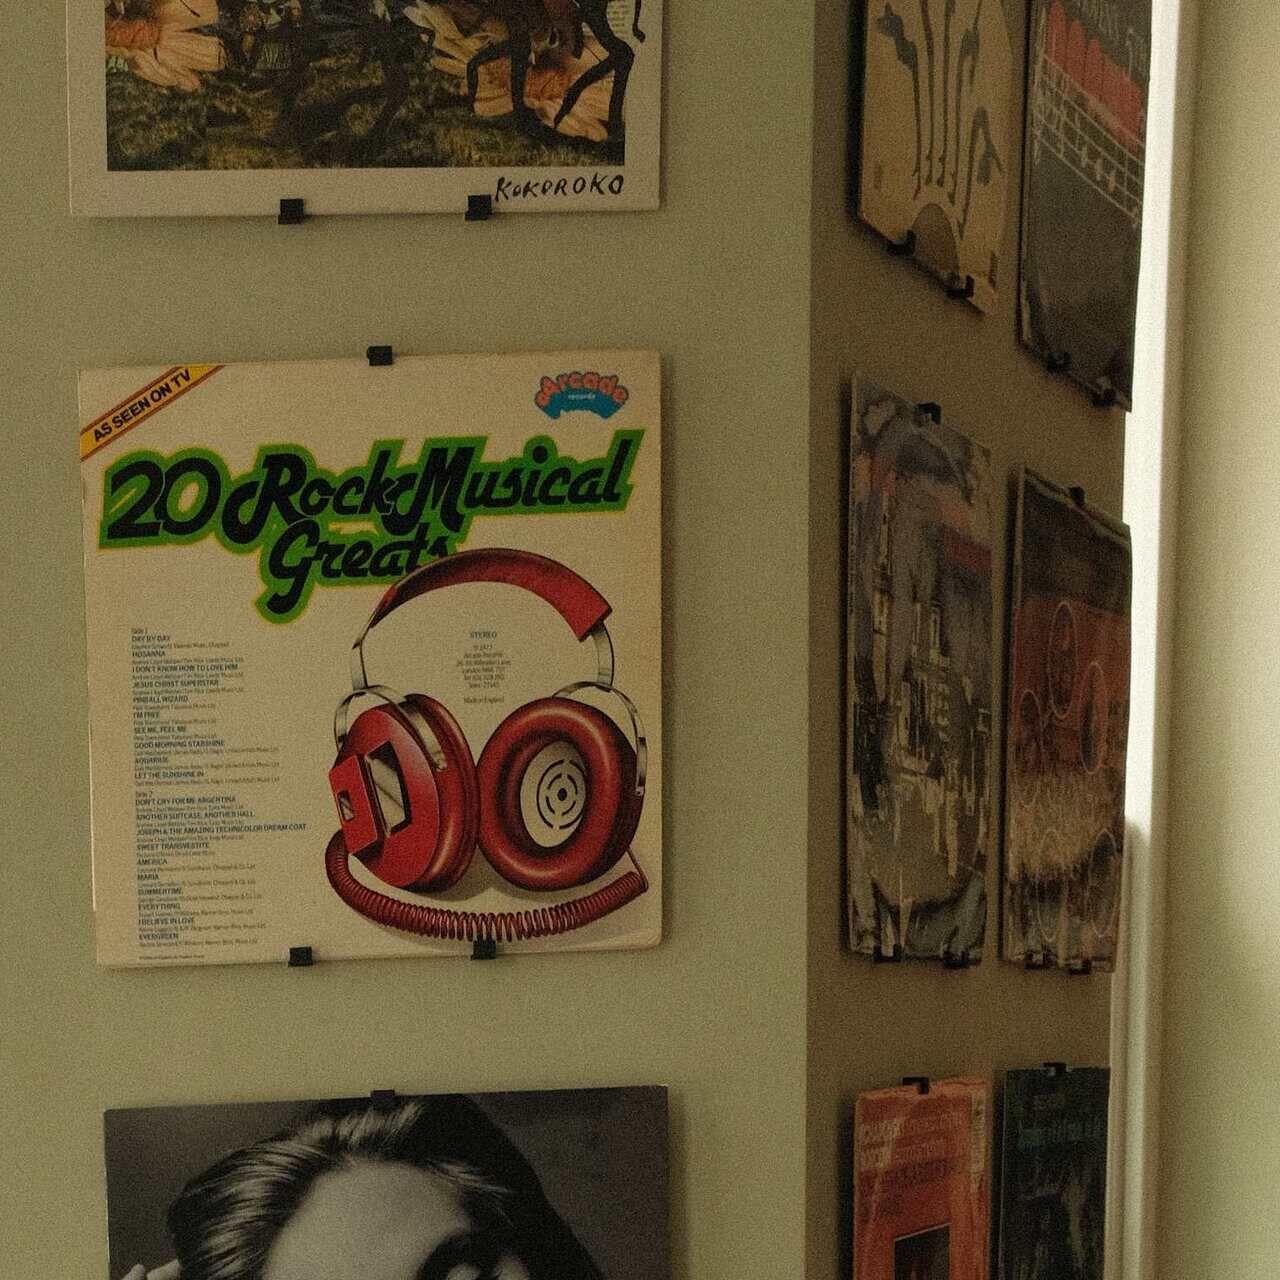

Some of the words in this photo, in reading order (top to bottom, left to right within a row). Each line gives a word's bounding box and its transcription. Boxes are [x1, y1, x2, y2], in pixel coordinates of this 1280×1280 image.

[94, 422, 113, 442] AS
[112, 397, 151, 428] SEEN
[150, 382, 173, 402] ON
[170, 368, 191, 387] TV
[535, 371, 629, 409] Arcade
[107, 457, 222, 540] 20
[221, 446, 396, 543] Rock
[375, 438, 631, 536] Musical
[266, 520, 452, 614] Greats
